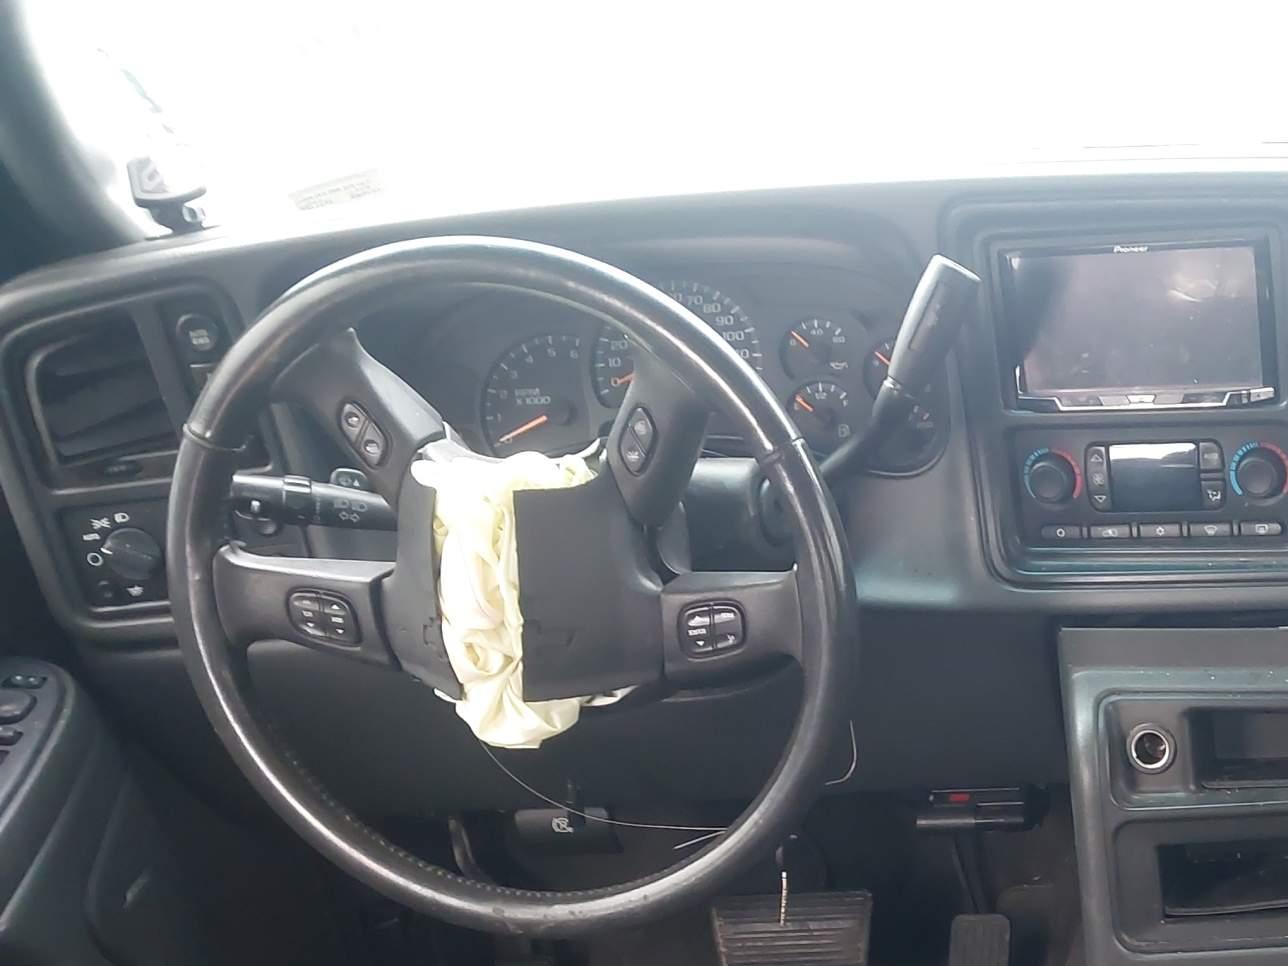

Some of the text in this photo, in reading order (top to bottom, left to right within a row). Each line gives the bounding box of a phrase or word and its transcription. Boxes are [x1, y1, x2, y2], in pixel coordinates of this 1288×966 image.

[688, 295, 703, 305] 70
[703, 303, 721, 314] 80
[715, 315, 734, 326] 90
[722, 331, 744, 342] 100
[608, 357, 621, 367] 10
